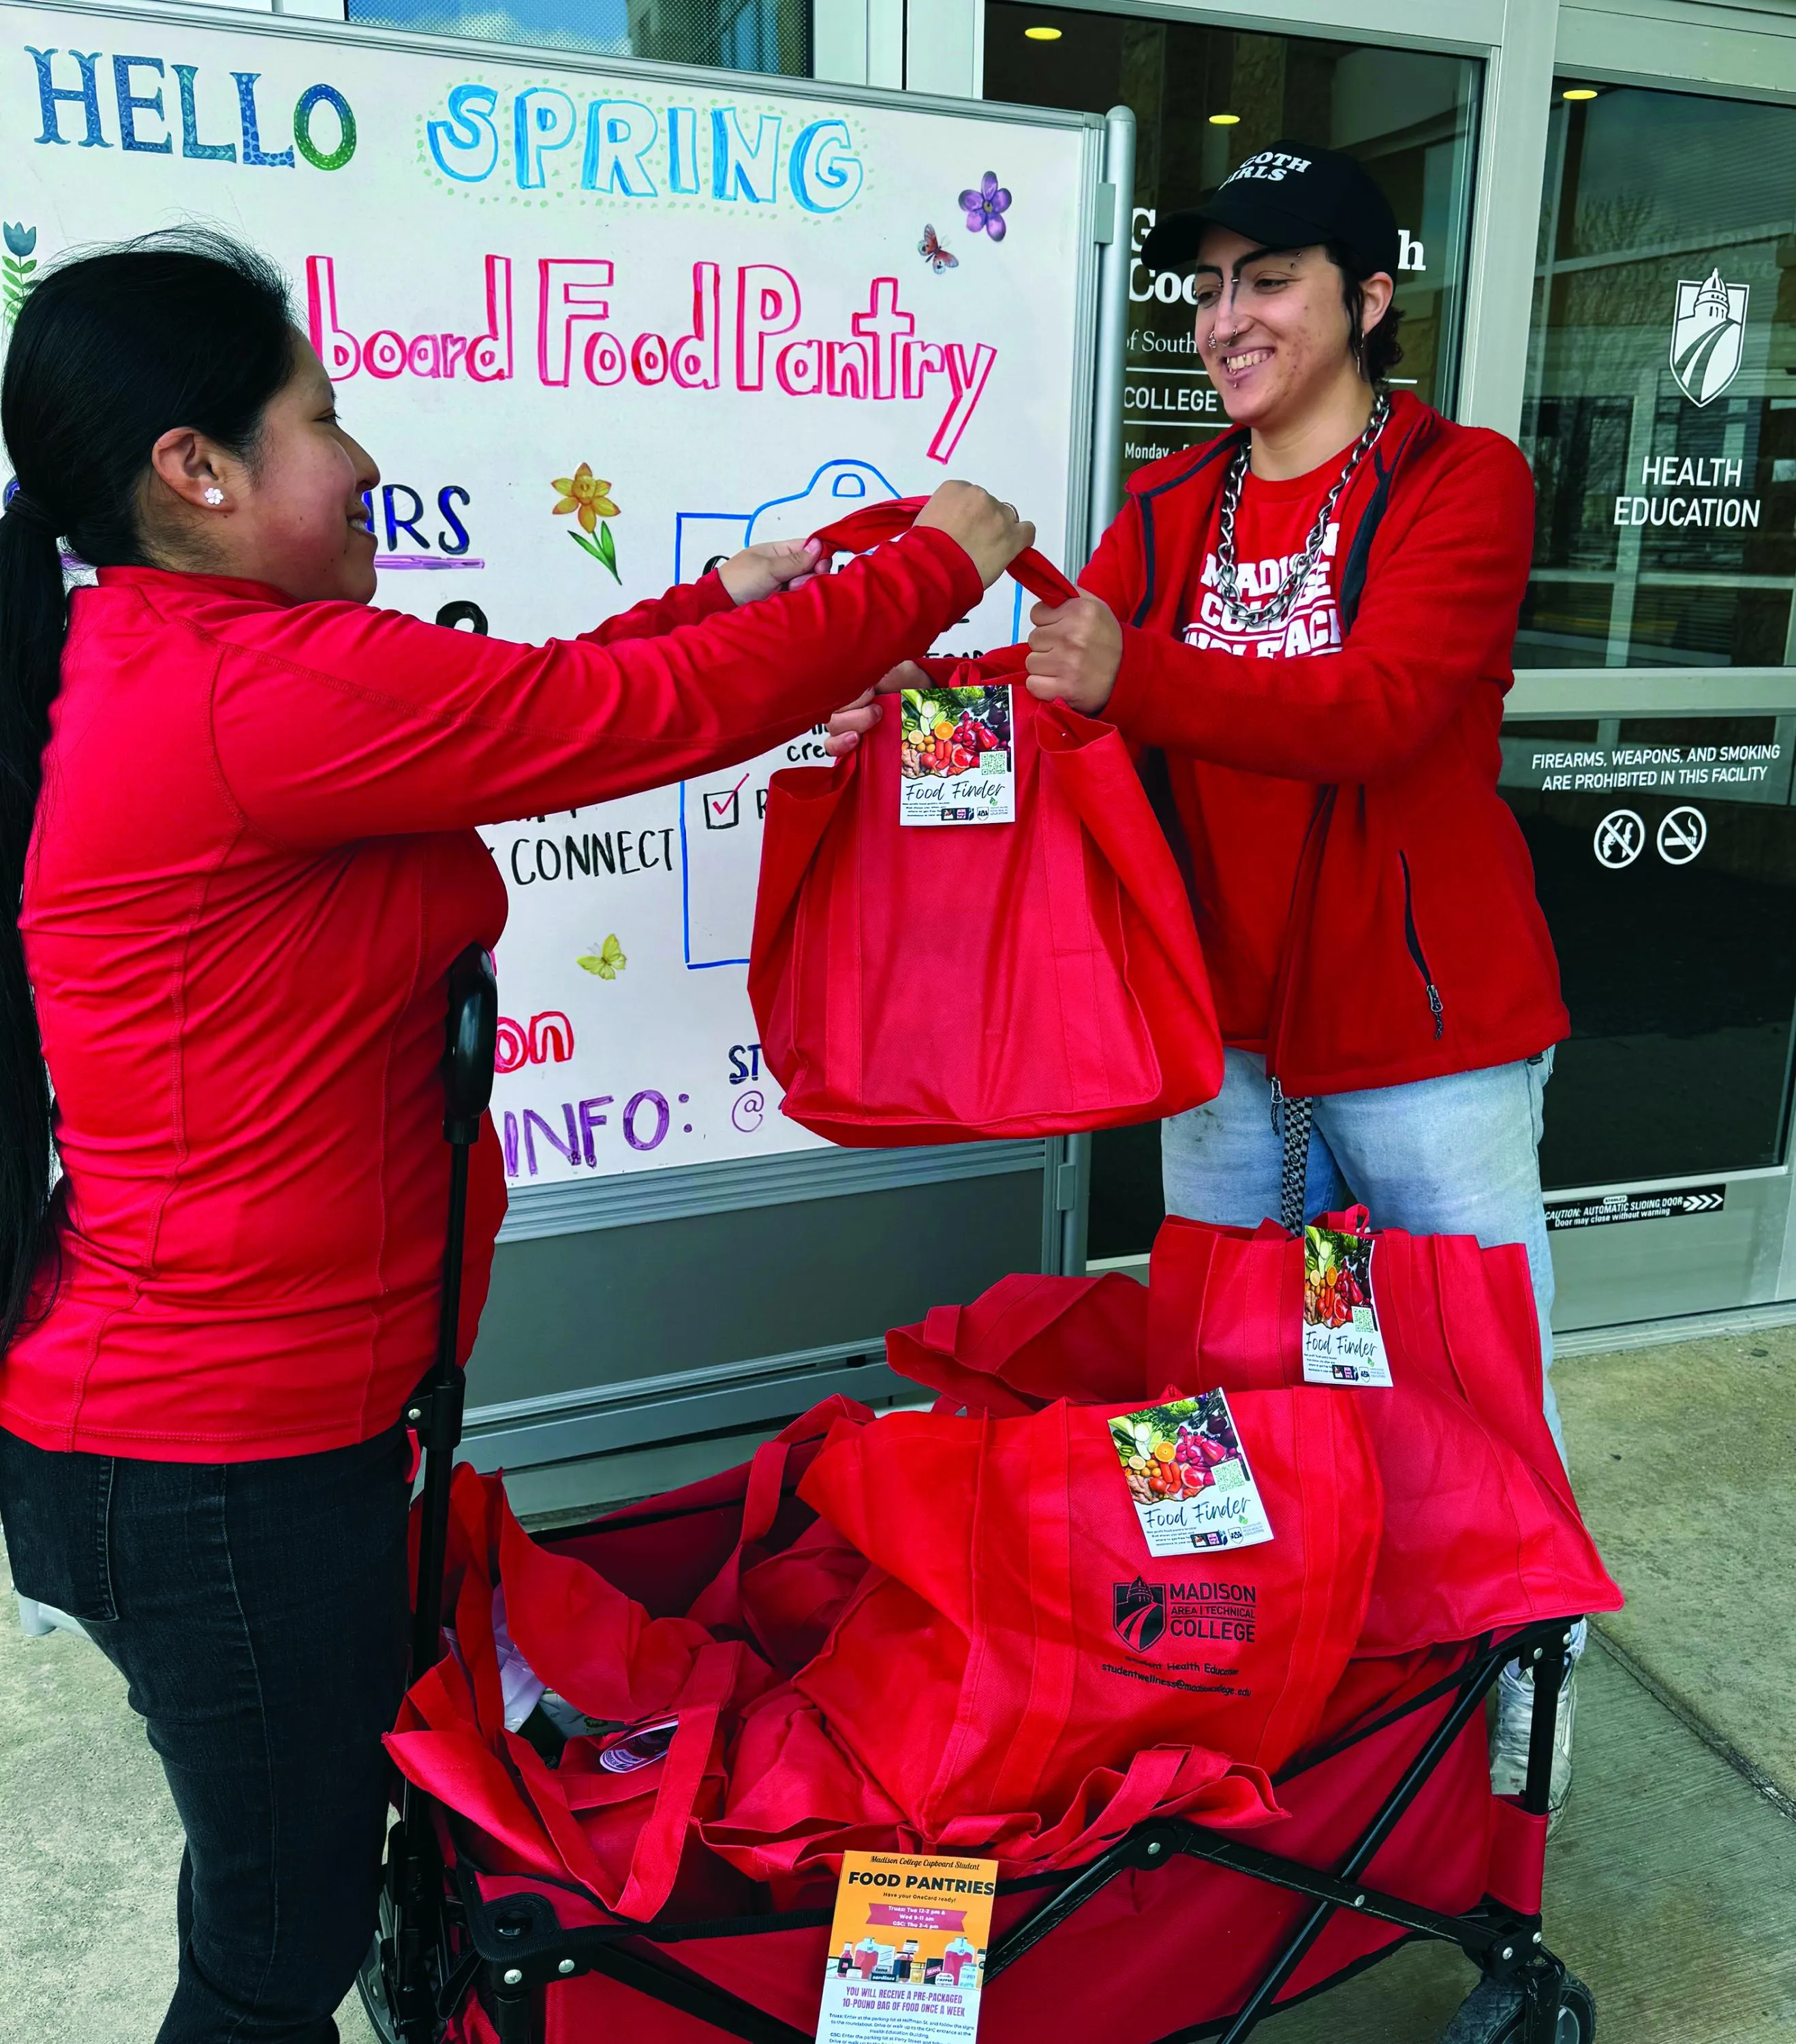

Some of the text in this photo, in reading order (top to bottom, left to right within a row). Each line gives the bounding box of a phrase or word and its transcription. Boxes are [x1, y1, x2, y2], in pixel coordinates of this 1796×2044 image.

[24, 46, 356, 171] HELLO
[427, 84, 863, 214] SPRING
[1240, 151, 1312, 173] GOTH
[539, 259, 719, 388] Food
[738, 265, 997, 465] Pantry
[1124, 387, 1218, 412] COLLEGE
[1641, 456, 1742, 487] HEALTH
[1613, 497, 1760, 527] EDUCATION
[1532, 744, 1780, 769] FIREARMS, WEAPONS, AND SMOKING
[905, 779, 1006, 801] Food Finder
[1542, 766, 1767, 791] ARE PROHIBITED IN THIS FACILITY
[511, 828, 675, 885] CONNECT
[503, 1089, 692, 1177] INFO:
[1544, 1196, 1683, 1220] CAUTION: AUTOMATIC SLIDING DOOR
[1555, 1207, 1671, 1227] Door may close without warning
[1305, 1331, 1377, 1358] Food Finder
[1143, 1496, 1252, 1528] Food Finder
[1169, 1582, 1256, 1603] MADISON
[1171, 1606, 1256, 1619] AREA TECHNICAL
[1170, 1619, 1256, 1643] COLLEGE
[1166, 1662, 1201, 1672] Health
[870, 1856, 980, 1870] Madison College Cupboard Student
[849, 1872, 994, 1895] FOOD PANTRIES
[846, 1986, 963, 2004] YOU WILL RECEIVE A PRE-PACKAGED
[843, 1998, 965, 2017] 10-POUND BAG OF FOOD ONCE A WEEK
